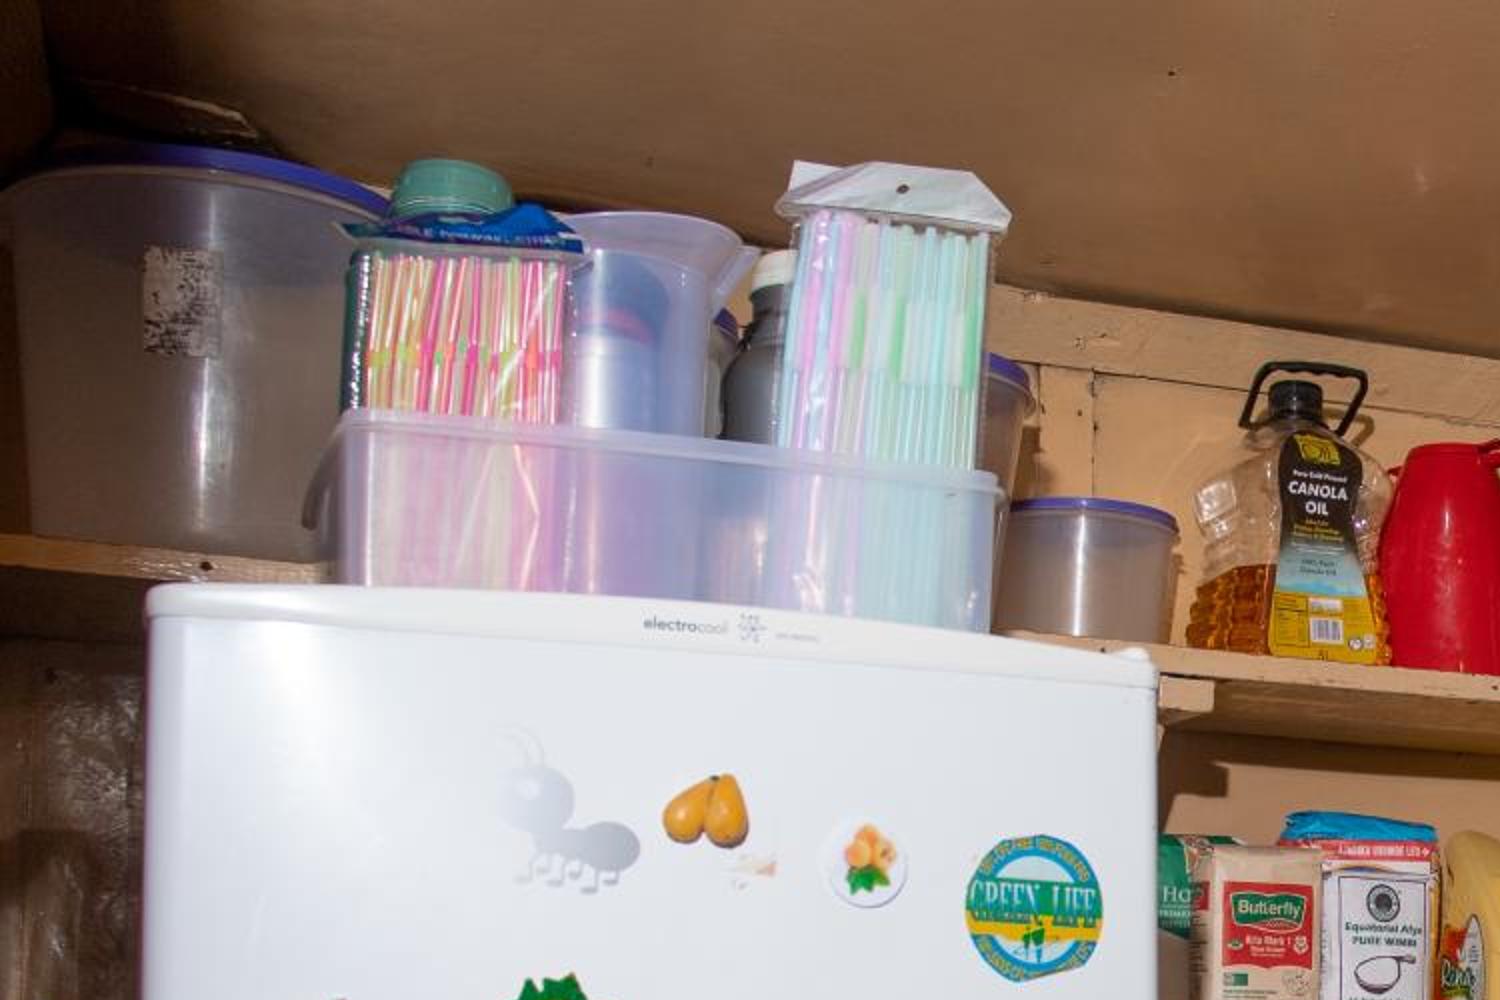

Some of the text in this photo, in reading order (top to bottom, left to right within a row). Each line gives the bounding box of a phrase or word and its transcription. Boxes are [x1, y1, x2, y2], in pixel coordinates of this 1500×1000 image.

[1287, 481, 1349, 500] CANOLA
[1304, 501, 1329, 516] OIL
[643, 616, 729, 635] electrocool
[971, 880, 1096, 913] GREEN LIFE
[1238, 900, 1301, 919] Butterfly
[1345, 922, 1398, 933] Equatorial
